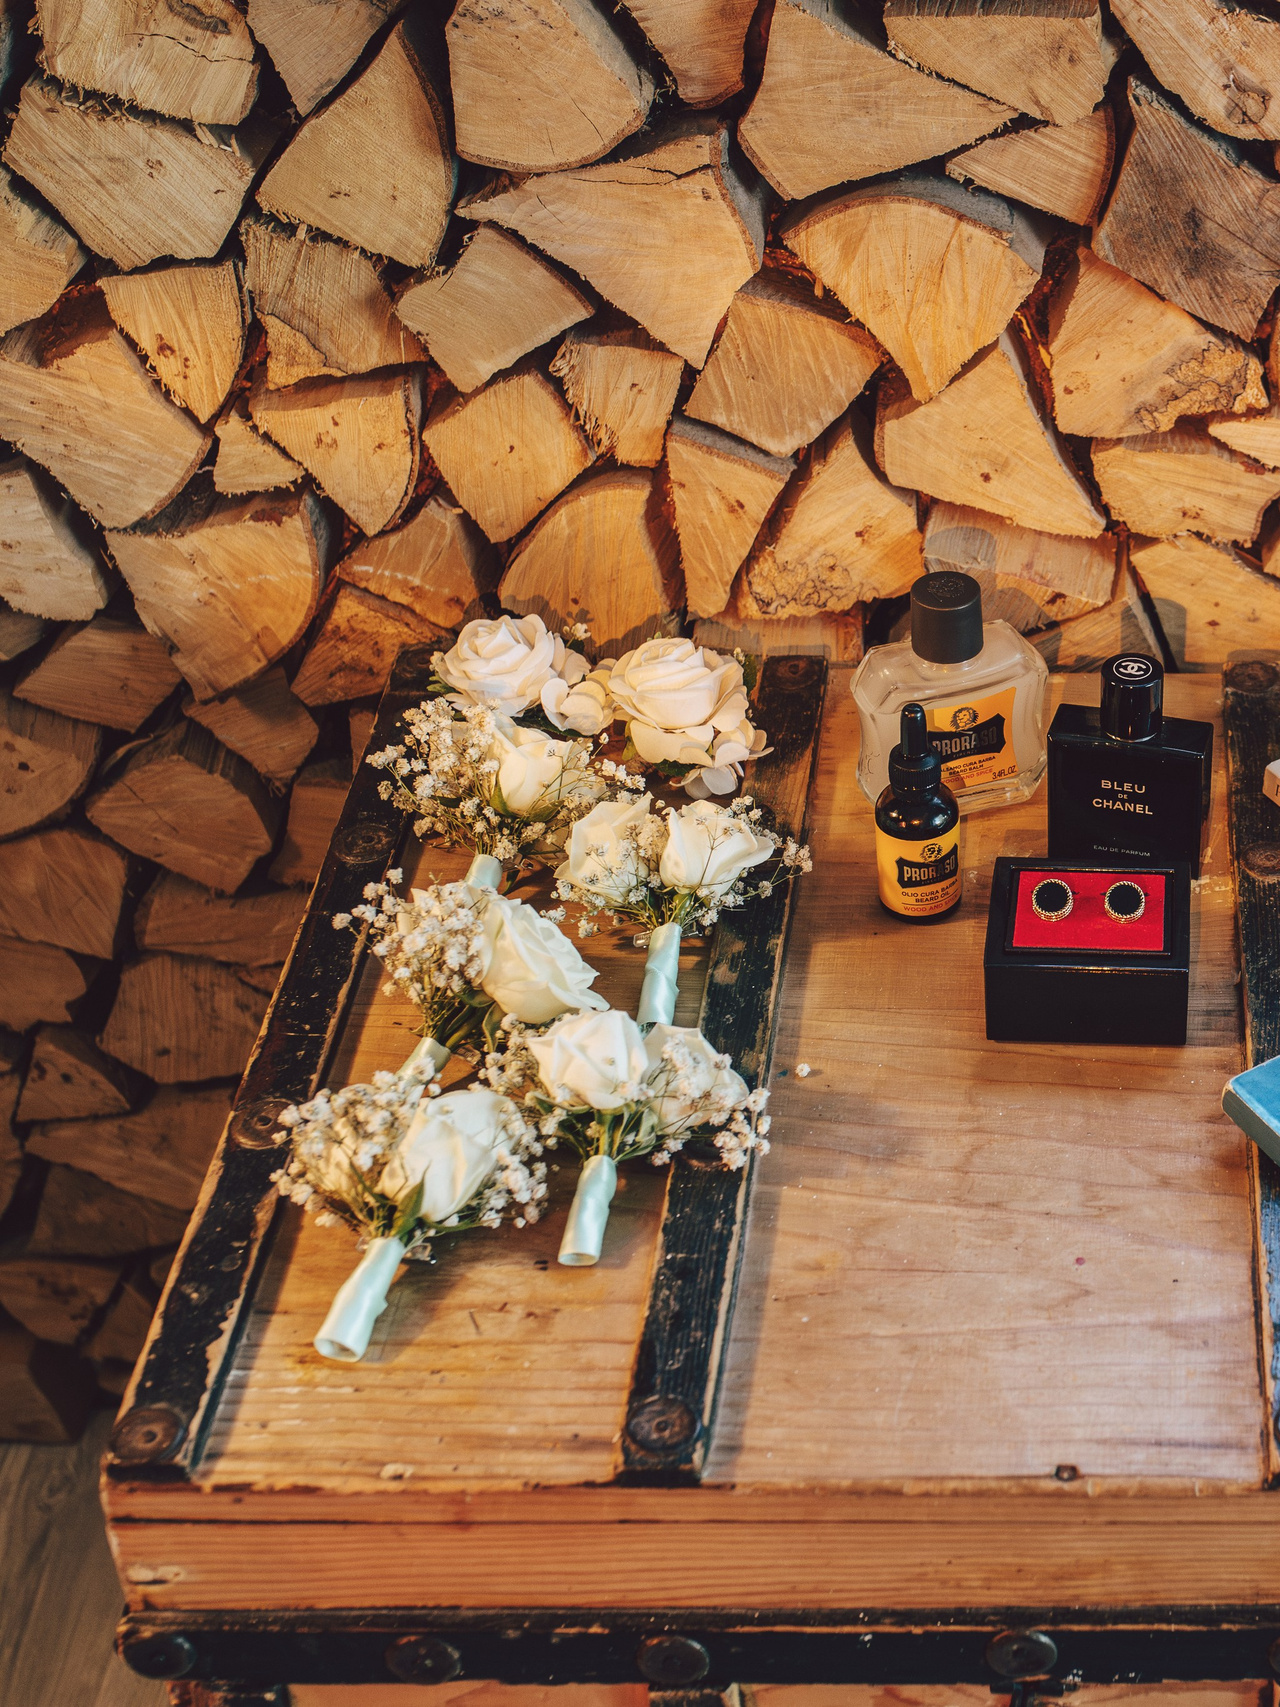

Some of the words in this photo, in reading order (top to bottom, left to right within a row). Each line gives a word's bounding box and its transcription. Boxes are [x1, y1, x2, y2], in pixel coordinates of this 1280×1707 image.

[962, 760, 977, 769] CURA
[978, 755, 996, 765] BARBA
[948, 767, 968, 776] BEARD
[968, 763, 984, 771] BALM
[961, 773, 975, 781] AND
[975, 768, 993, 778] SPICE
[1101, 779, 1146, 794] BLEU
[1092, 798, 1154, 816] CHANEL
[1121, 848, 1151, 857] PARFUM
[914, 895, 940, 903] BEARD
[940, 891, 950, 899] OIL
[920, 889, 940, 897] CURA
[928, 903, 944, 912] AND
